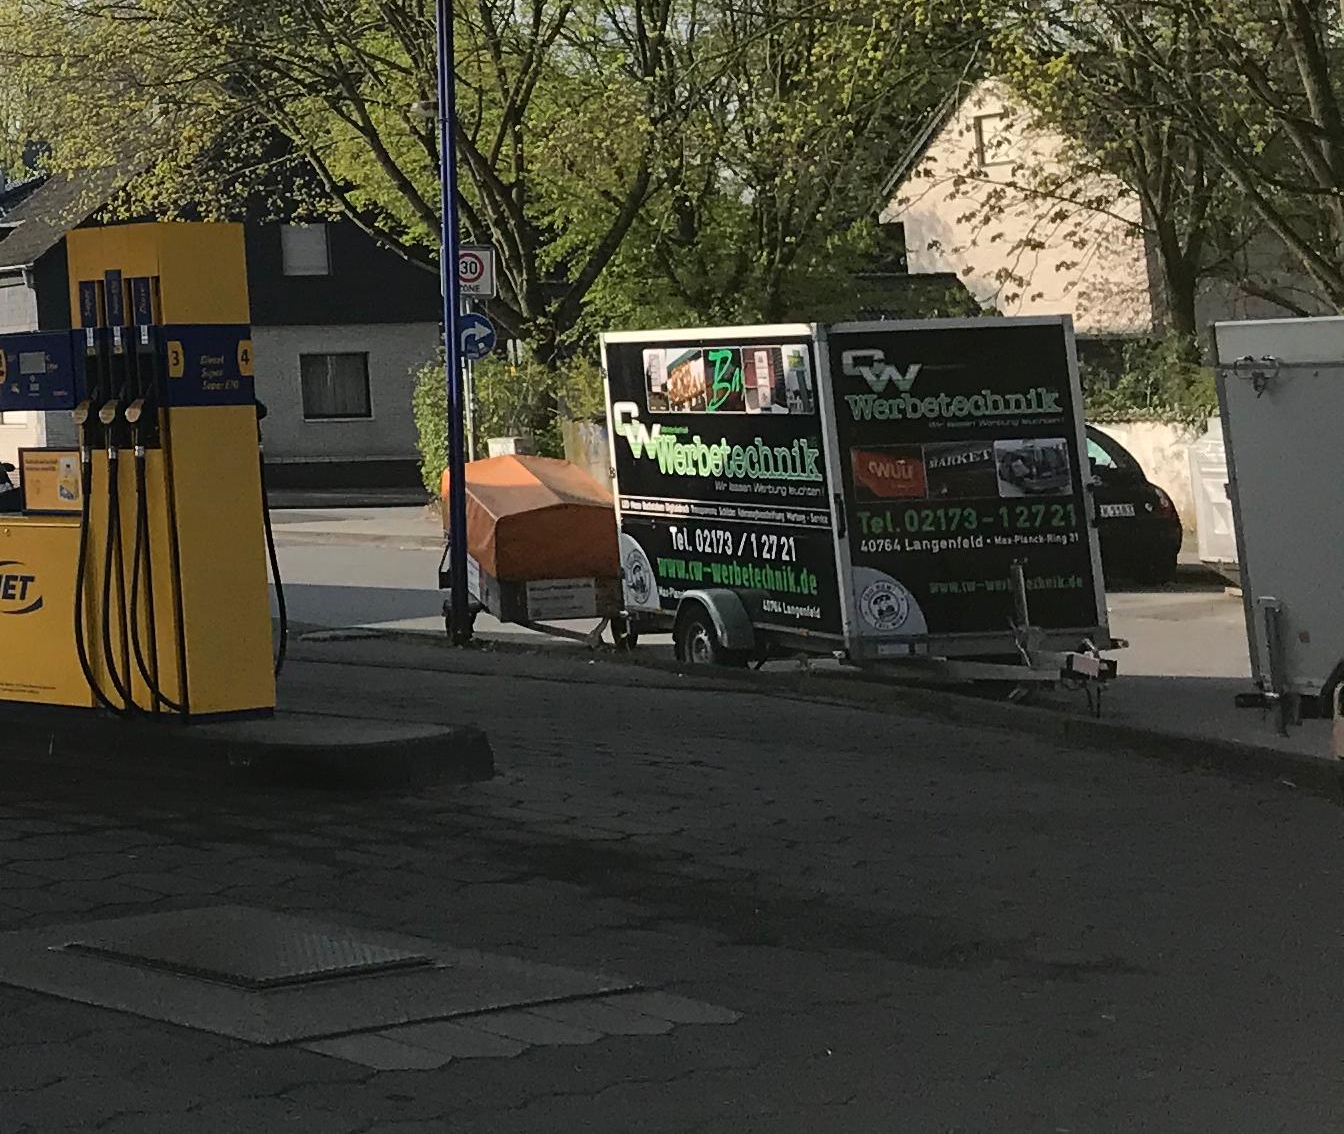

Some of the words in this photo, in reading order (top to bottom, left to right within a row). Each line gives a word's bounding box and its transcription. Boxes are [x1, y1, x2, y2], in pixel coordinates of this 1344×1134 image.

[461, 260, 478, 275] 30
[172, 350, 180, 366] 3
[241, 348, 250, 366] 4
[842, 349, 923, 393] CW
[845, 387, 1064, 421] Werbetechnik
[654, 434, 824, 482] Werbetechnik
[928, 449, 991, 468] MARKET
[858, 511, 901, 535] Tel.
[904, 507, 979, 533] 02173
[669, 526, 692, 551] Tel.
[696, 528, 733, 556] 02173
[861, 539, 902, 554] 40764
[905, 535, 984, 554] Langenfeld
[994, 535, 1068, 548] Max-Planck-Ring
[657, 557, 818, 595] www.cw-werbetechnik.de
[928, 576, 1084, 594] www.cw-werechnik.de
